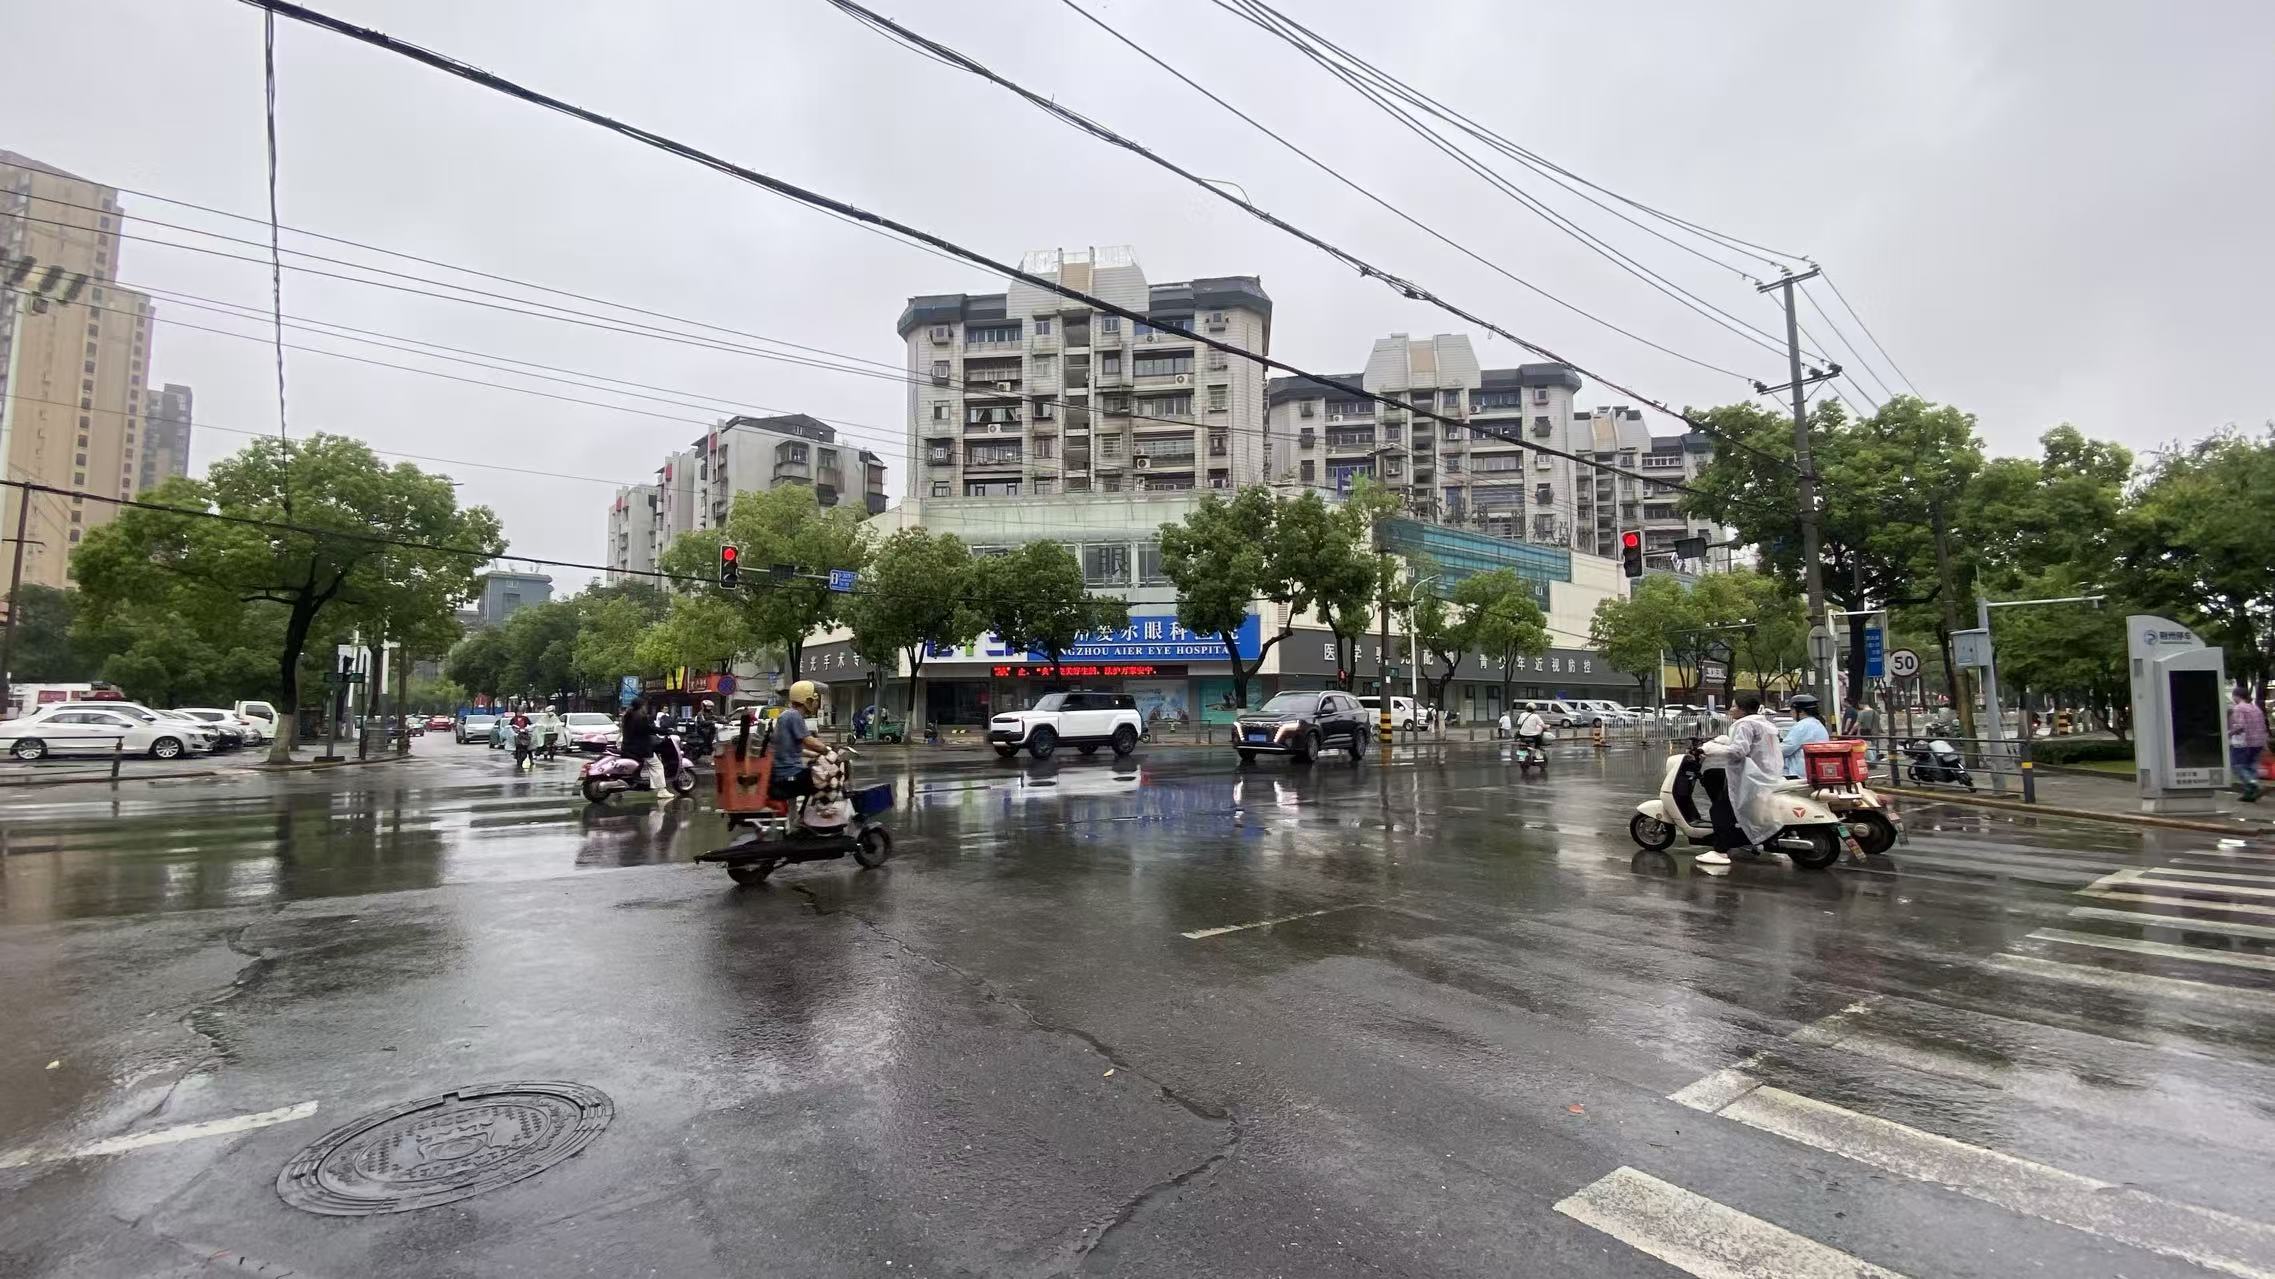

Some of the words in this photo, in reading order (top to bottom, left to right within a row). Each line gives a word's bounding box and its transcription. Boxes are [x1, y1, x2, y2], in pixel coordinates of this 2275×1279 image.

[1073, 620, 1239, 642] 州爱尔眼科
[1114, 646, 1143, 655] AIER
[1148, 646, 1171, 655] EYE
[1176, 645, 1230, 655] HOSPITA
[1894, 655, 1914, 670] 50
